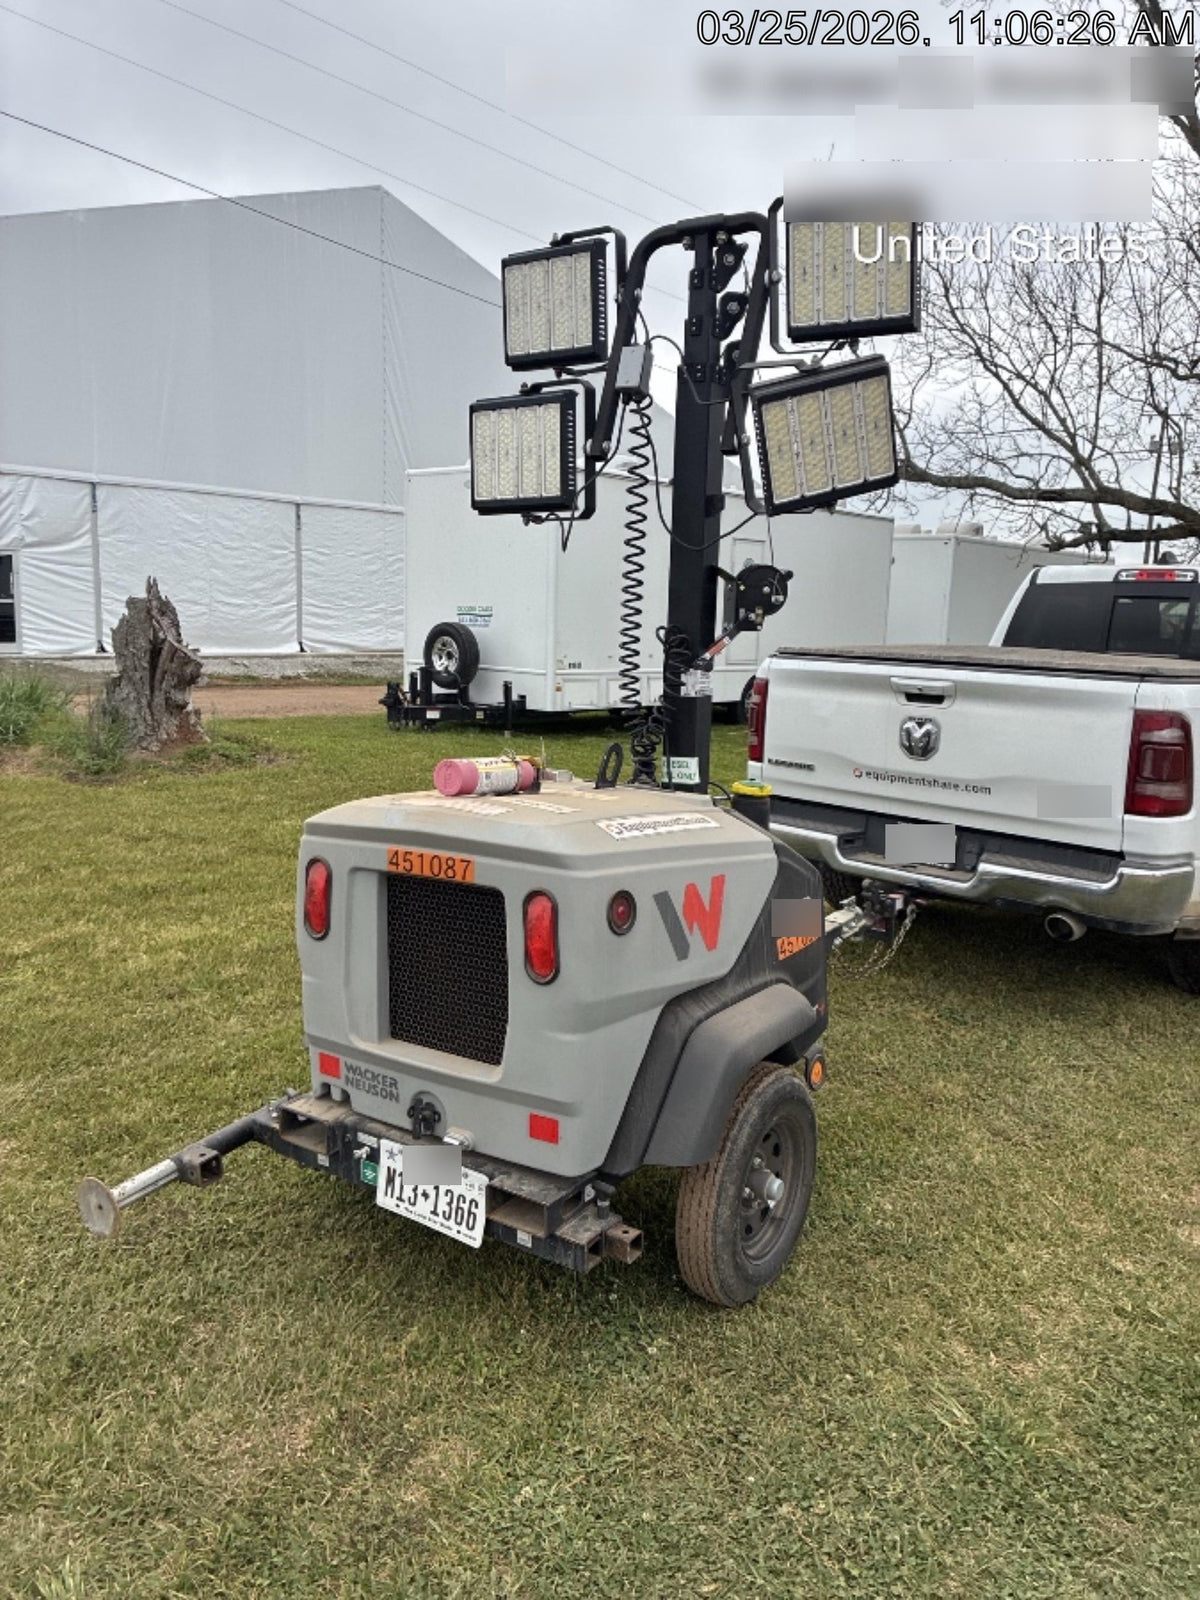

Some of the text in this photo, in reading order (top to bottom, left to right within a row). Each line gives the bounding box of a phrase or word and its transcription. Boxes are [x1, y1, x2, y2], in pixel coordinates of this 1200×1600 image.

[388, 848, 473, 883] 451087
[344, 1060, 399, 1091] WACKER
[344, 1074, 400, 1104] NEUSON
